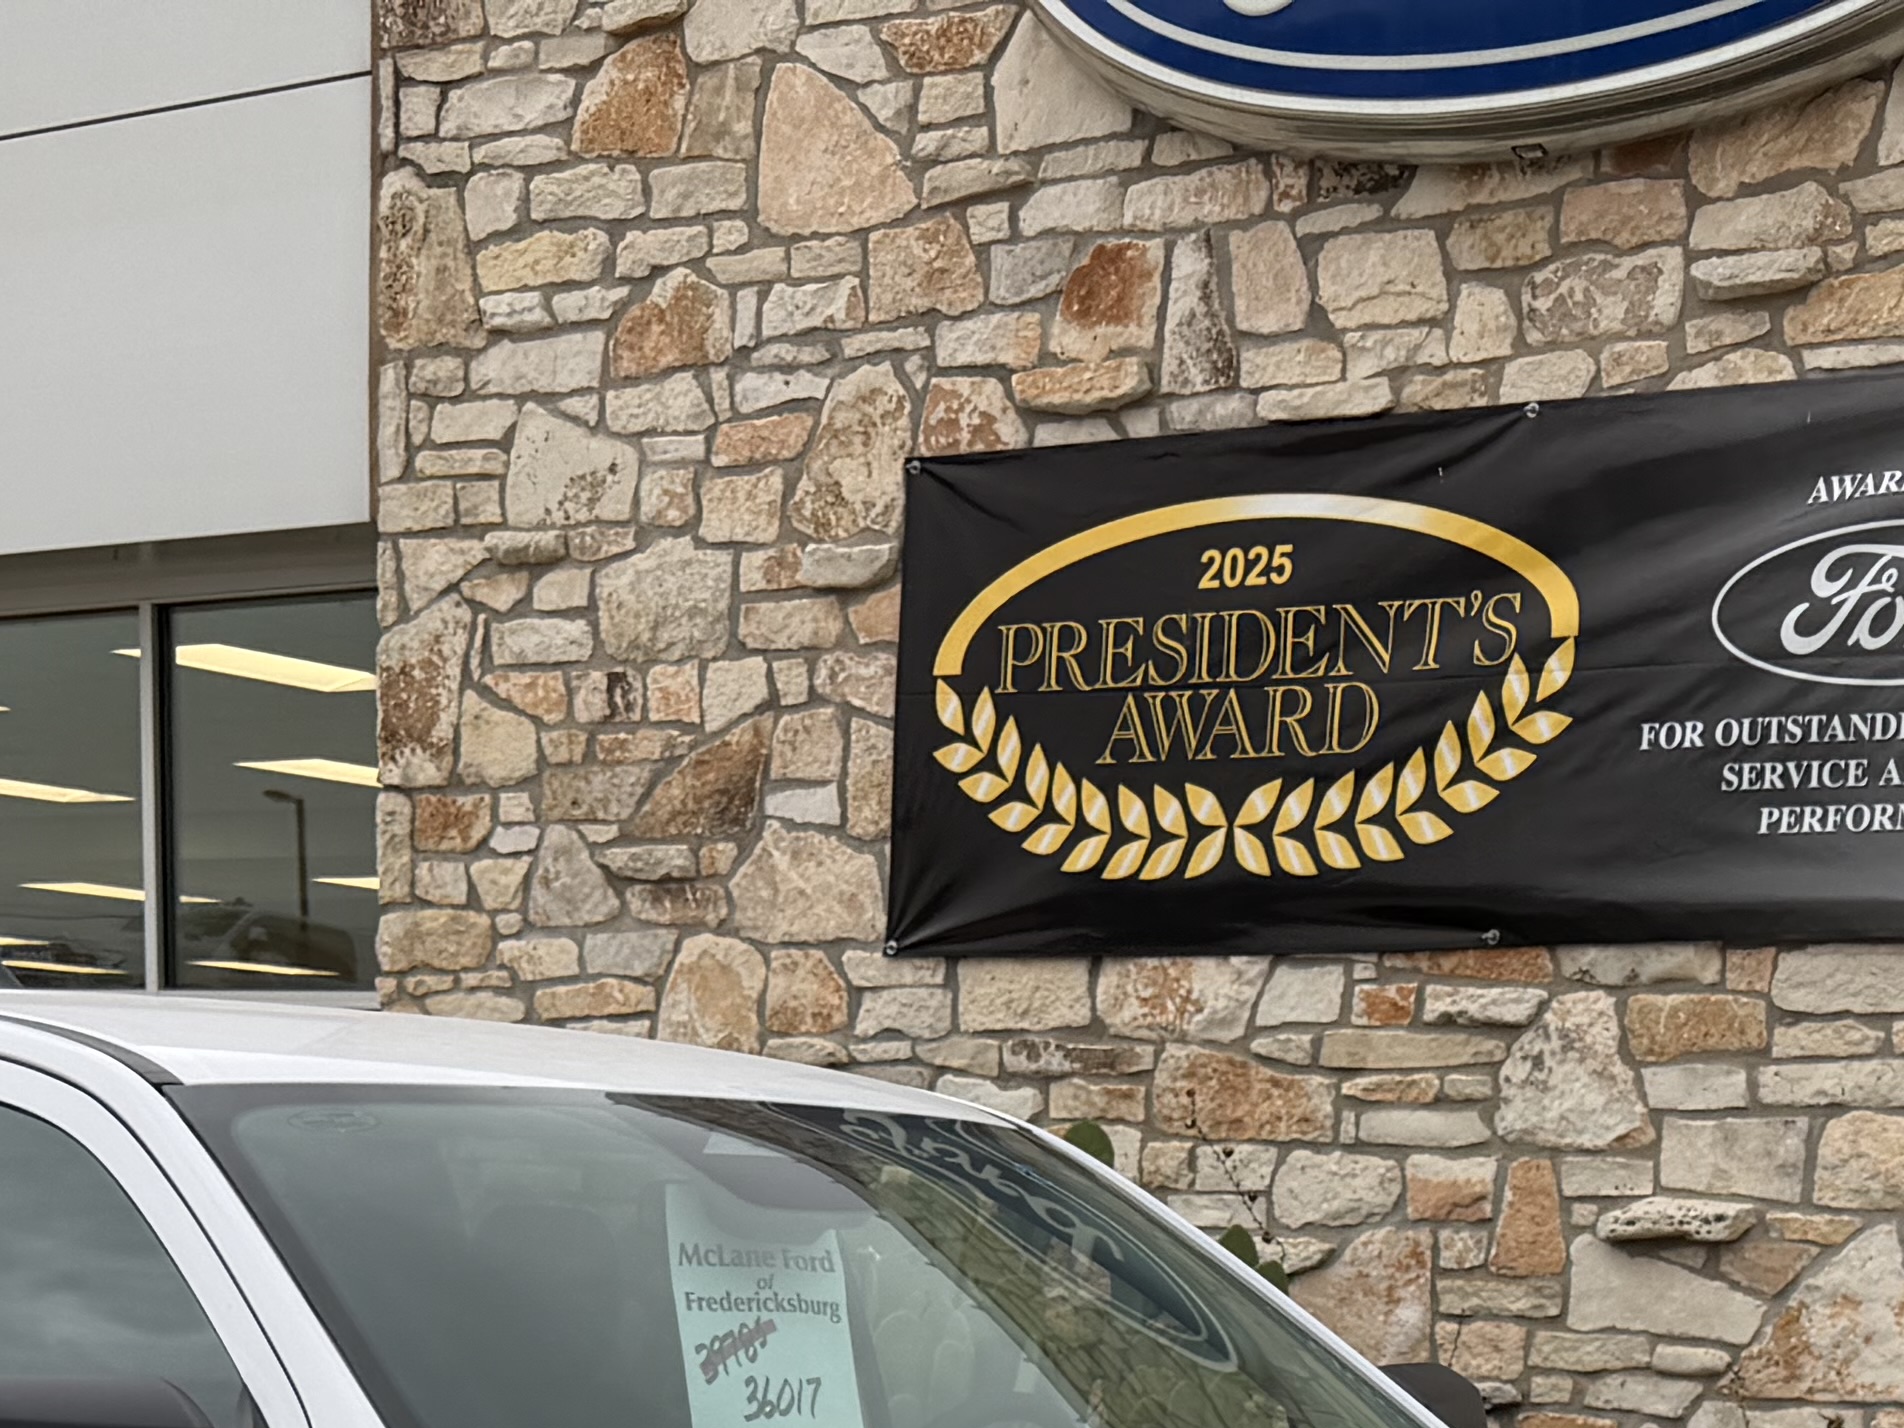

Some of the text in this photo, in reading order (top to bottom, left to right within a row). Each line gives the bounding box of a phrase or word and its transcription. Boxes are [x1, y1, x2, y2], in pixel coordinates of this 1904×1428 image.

[1197, 544, 1294, 590] 2025
[995, 590, 1523, 693] PRESIDENT'S
[1095, 681, 1380, 764] AWARD
[1638, 720, 1705, 752] FOR
[1720, 759, 1869, 793] SERVICE
[678, 1242, 837, 1274] McLane Ford
[756, 1274, 775, 1290] of
[684, 1290, 842, 1324] Fredericksburg
[744, 1375, 822, 1422] 36017
